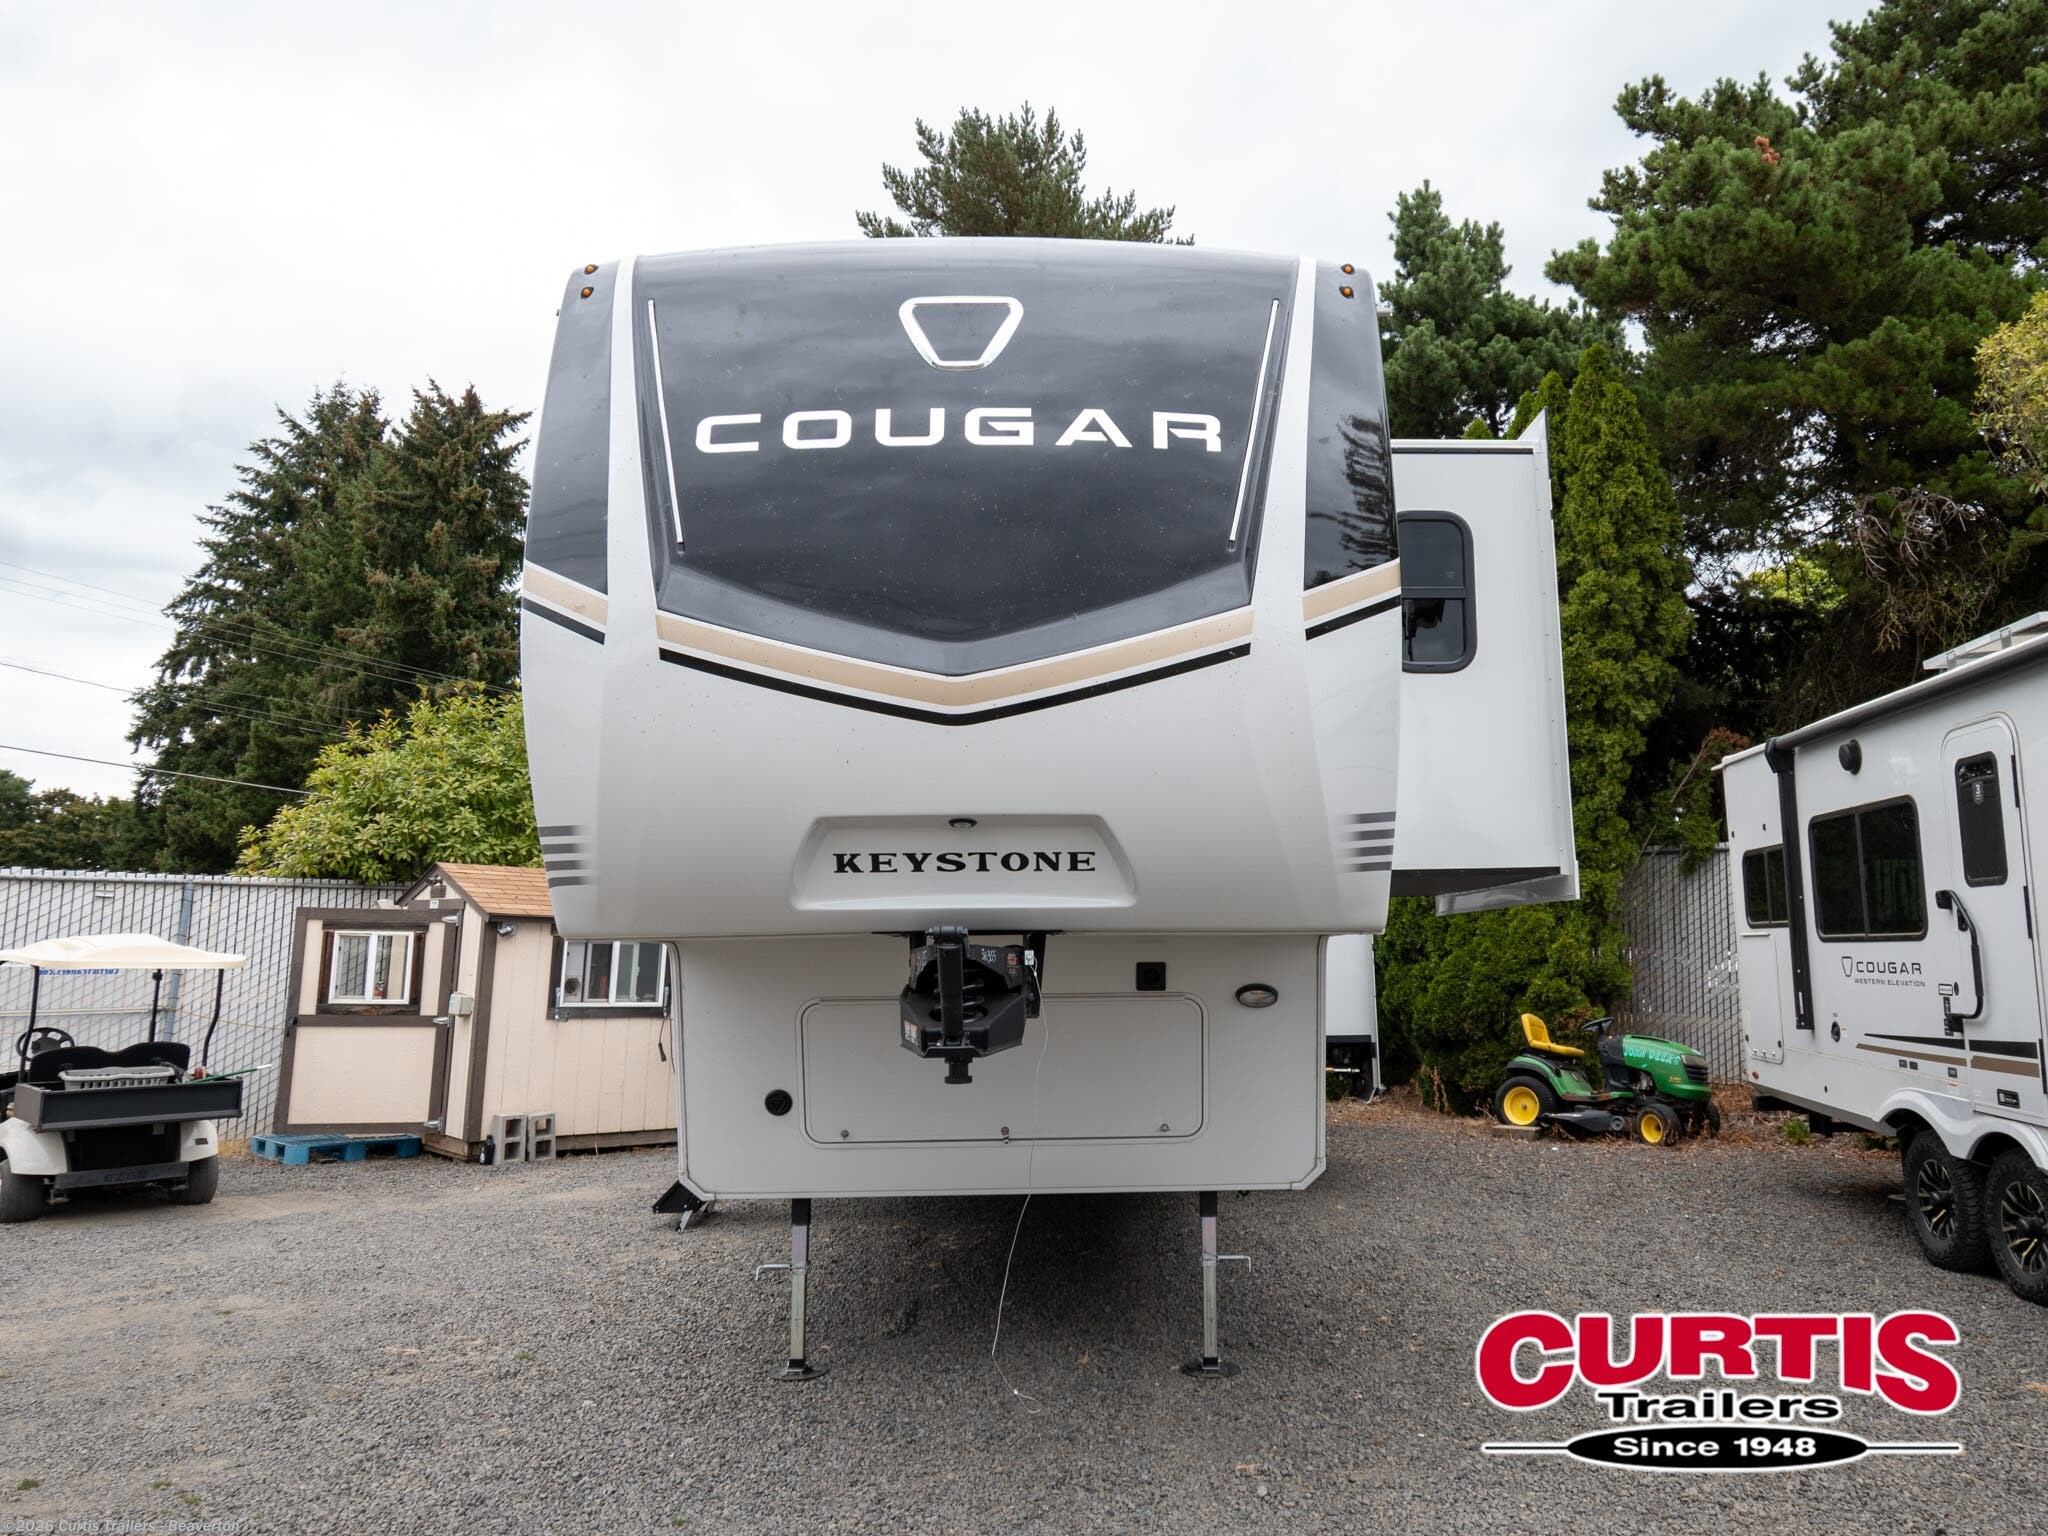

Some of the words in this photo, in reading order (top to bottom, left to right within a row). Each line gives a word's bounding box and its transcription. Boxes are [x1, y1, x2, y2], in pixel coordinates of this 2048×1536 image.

[695, 407, 1222, 454] COUGAR
[833, 851, 1096, 874] KEYSTONE
[1856, 961, 1922, 975] COUGAR
[1887, 979, 1926, 988] ELEVATION
